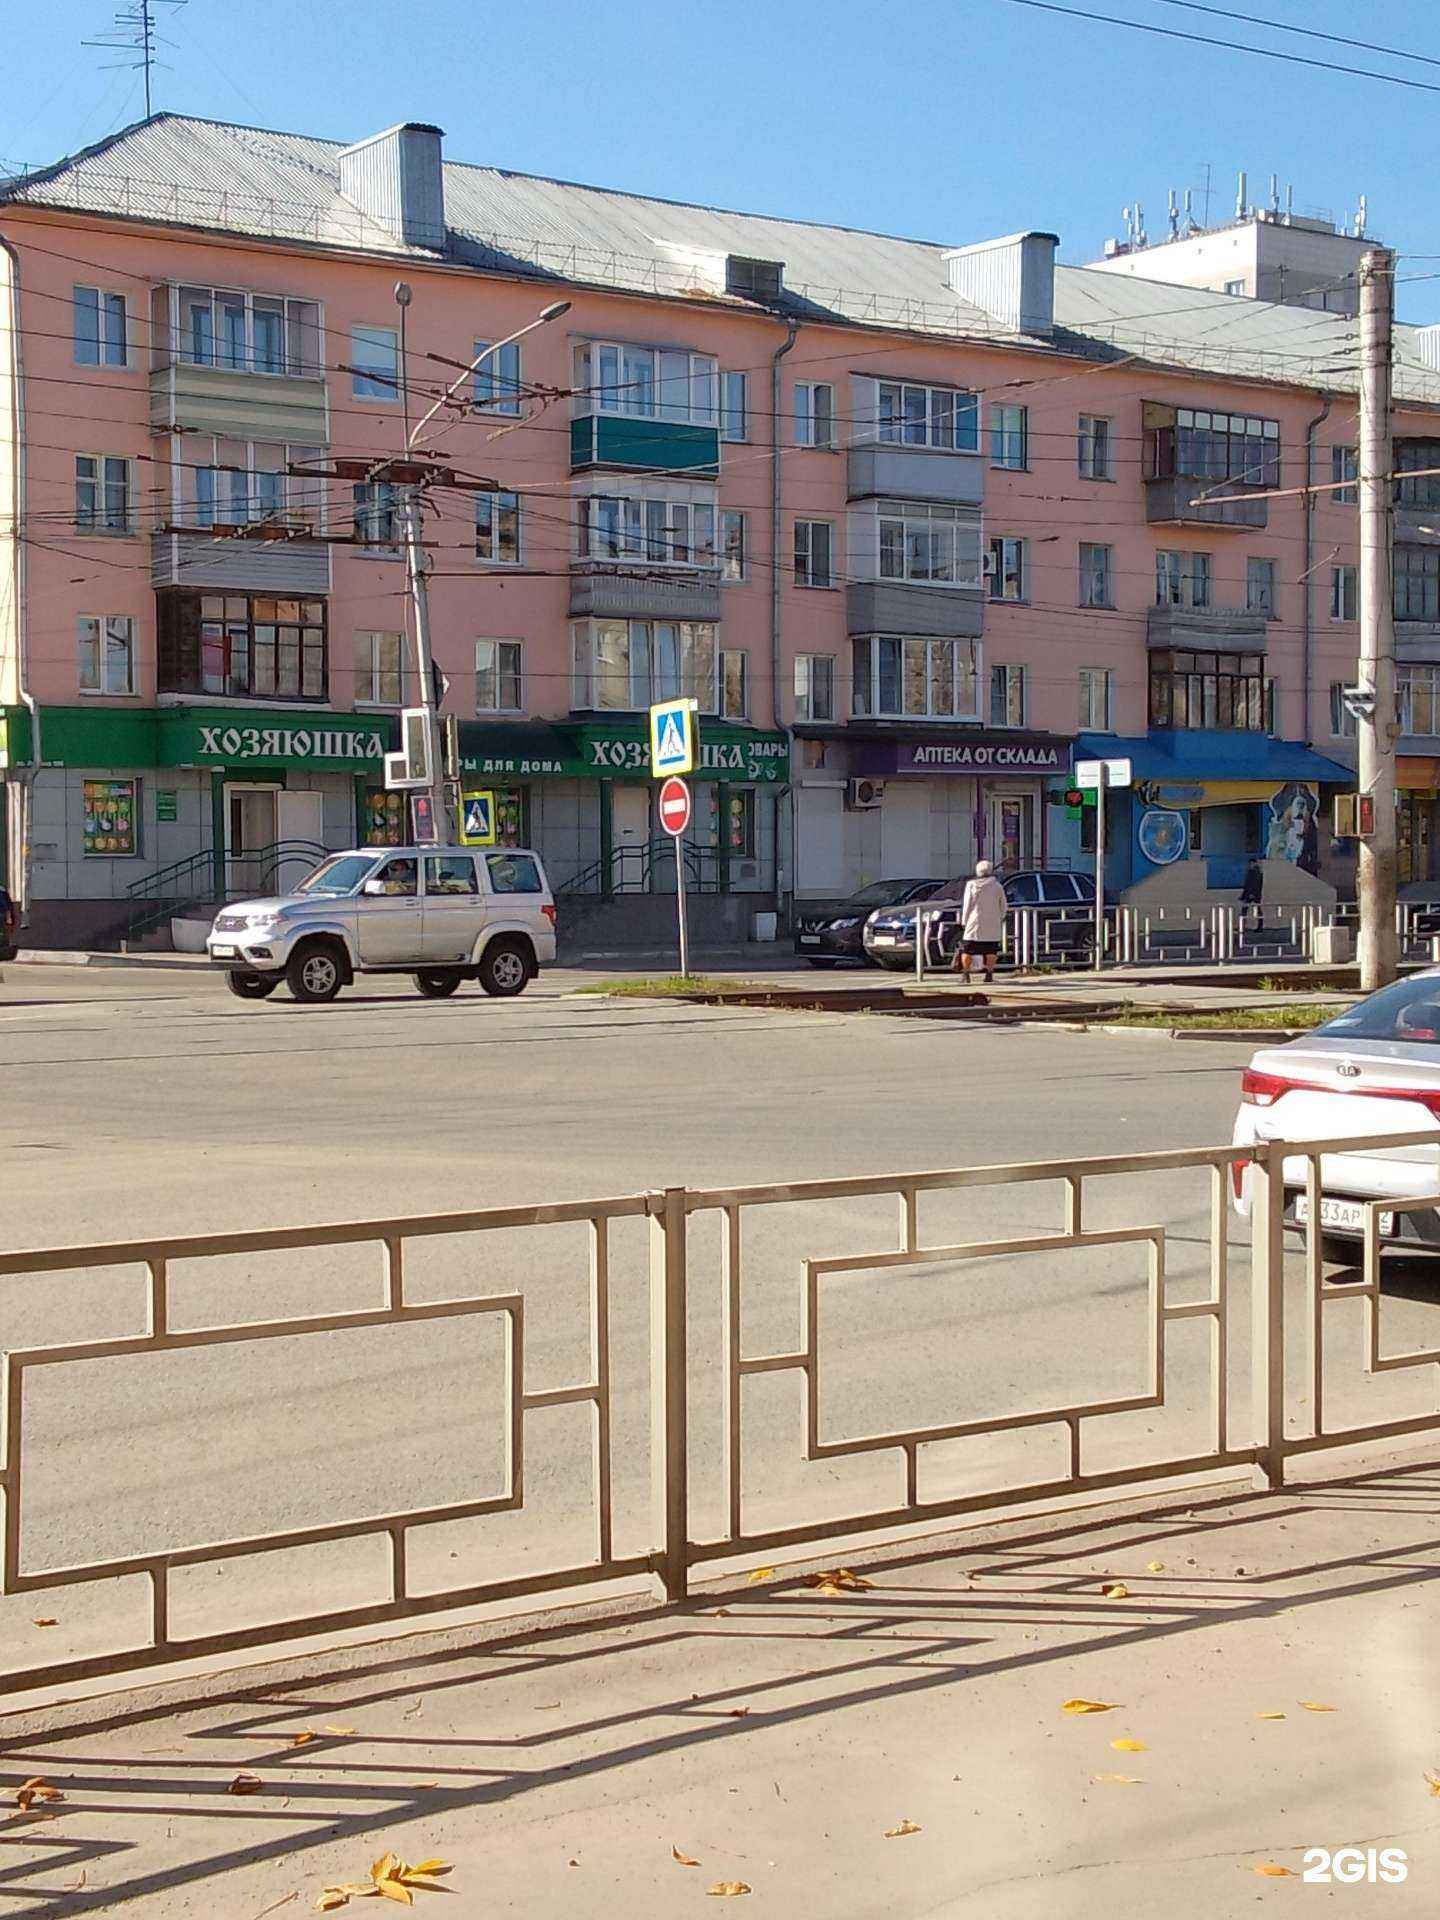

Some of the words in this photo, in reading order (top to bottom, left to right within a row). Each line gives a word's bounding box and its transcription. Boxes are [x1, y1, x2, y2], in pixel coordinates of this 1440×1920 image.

[198, 727, 384, 758] ХОЗЯЮШКА
[913, 746, 972, 763] АПТЕКА
[974, 747, 993, 764] ОТ
[996, 748, 1058, 765] СКЛАДА
[483, 760, 515, 773] ДЛЯ
[520, 760, 562, 774] ДОМА
